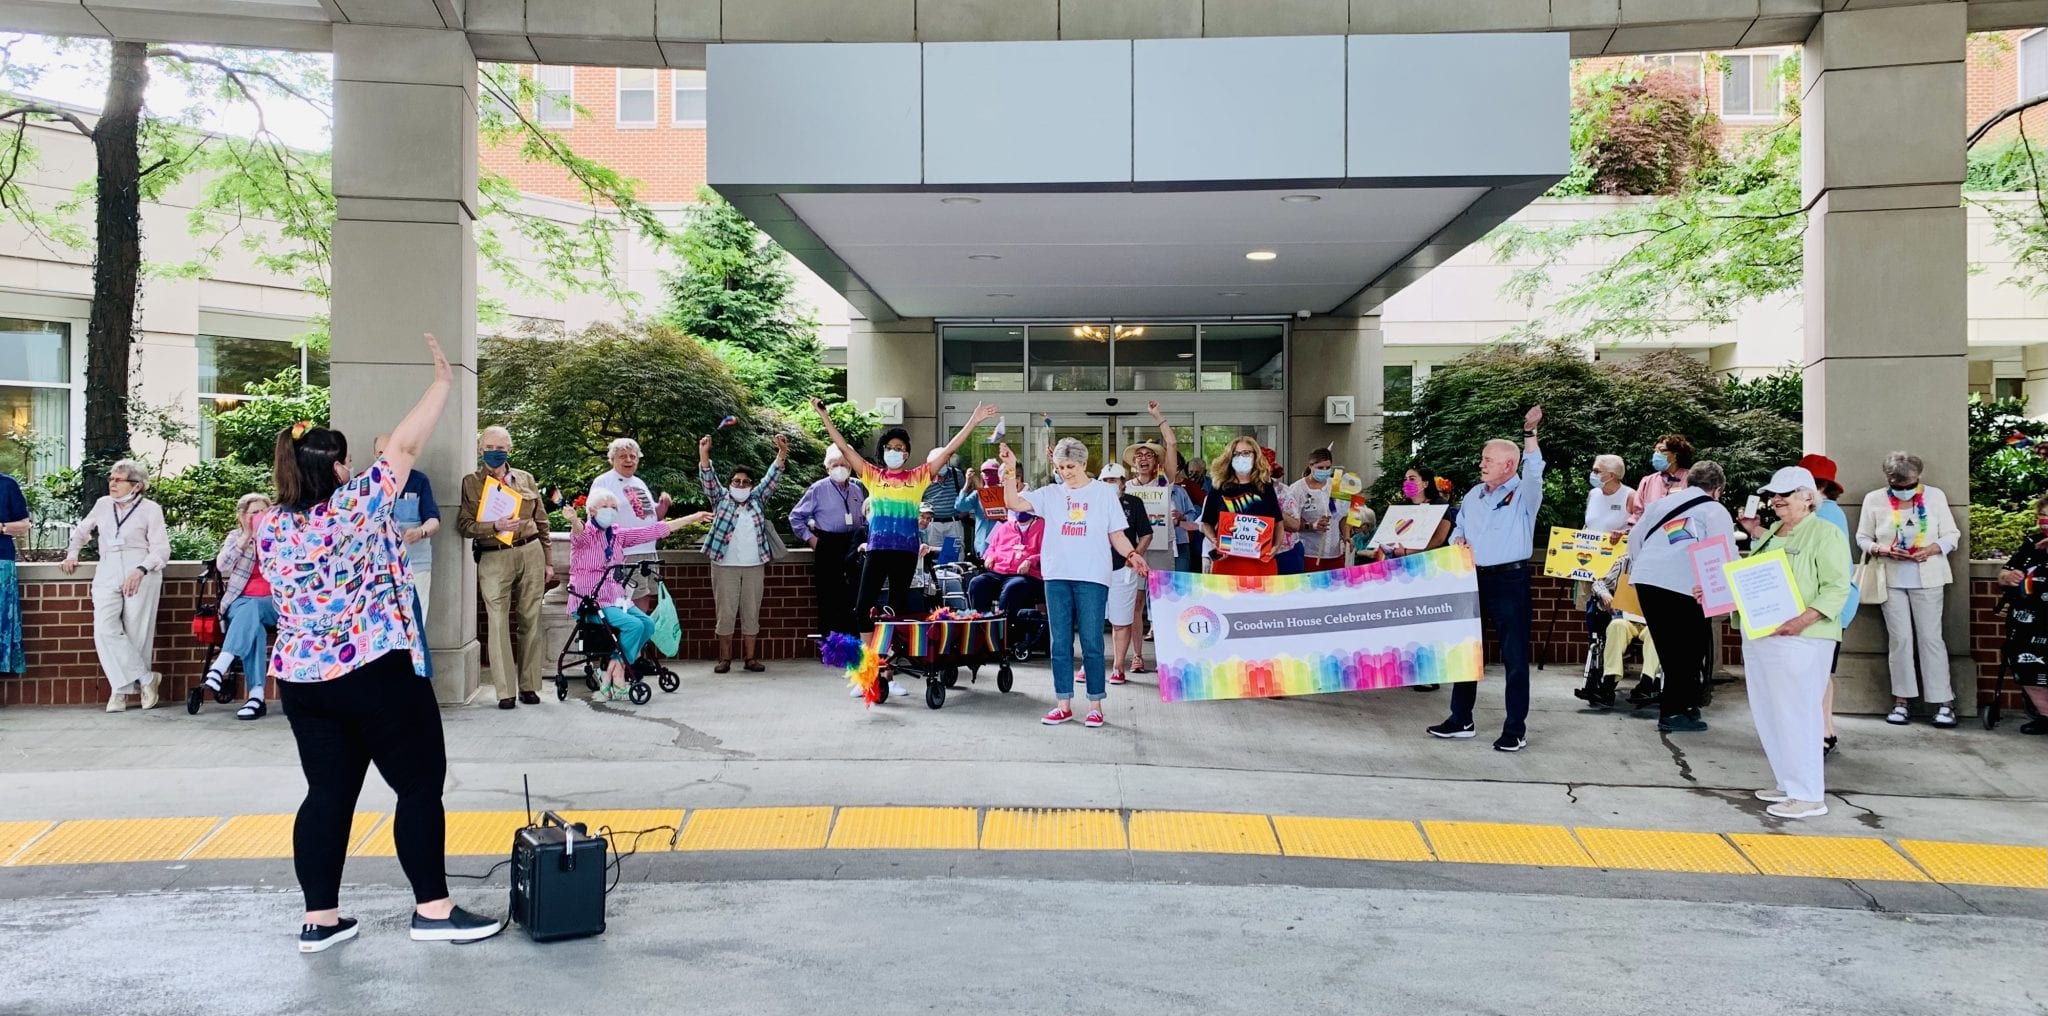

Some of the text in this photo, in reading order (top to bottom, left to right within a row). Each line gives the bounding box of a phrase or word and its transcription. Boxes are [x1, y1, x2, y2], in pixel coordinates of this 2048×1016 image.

[1083, 502, 1088, 511] a
[1236, 516, 1257, 524] LOVE
[1061, 524, 1087, 536] Mom!
[1234, 534, 1256, 542] LOVE
[1576, 532, 1601, 542] PRIDE
[1572, 570, 1593, 579] ALLY
[1233, 602, 1453, 632] Goodwin House Celebrates Pride Month
